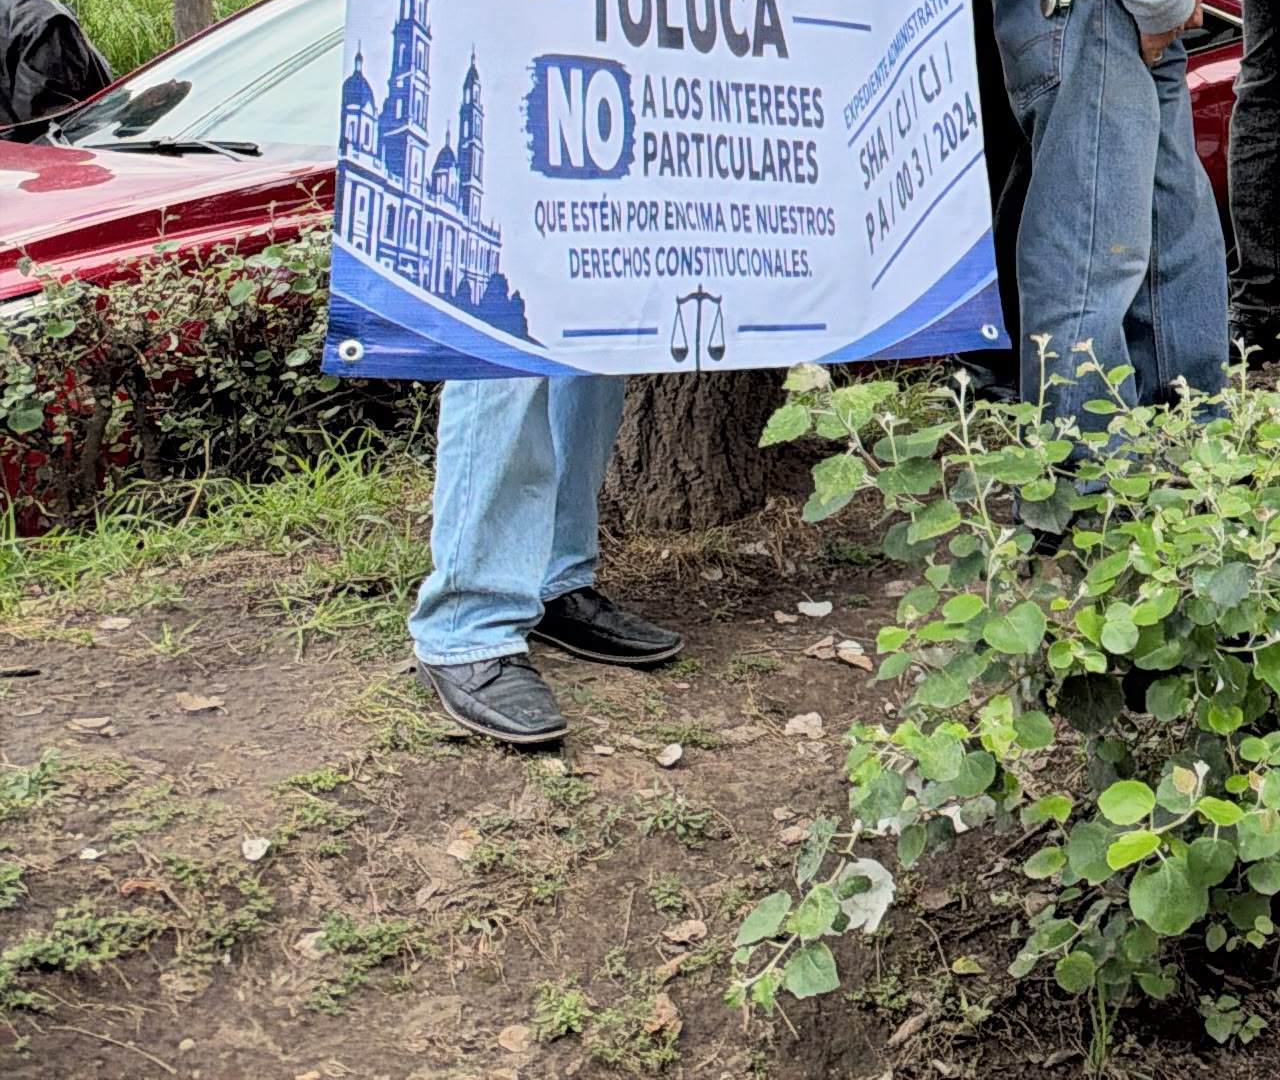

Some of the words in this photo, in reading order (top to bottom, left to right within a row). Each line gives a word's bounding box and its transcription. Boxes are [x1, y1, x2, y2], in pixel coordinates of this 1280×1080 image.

[547, 66, 628, 171] NO
[642, 75, 668, 118] A
[671, 77, 704, 121] LOS
[710, 81, 825, 129] INTERESES
[843, 57, 889, 130] EXPEDIENTE
[643, 131, 819, 184] PARTICULARES
[535, 201, 568, 236] QUE
[571, 192, 623, 233] ESTÉN
[628, 201, 660, 233] POR
[665, 201, 727, 234] ENCIMA
[732, 204, 752, 234] DE
[757, 205, 836, 236] NUESTROS
[569, 248, 651, 279] DERECHOS
[656, 248, 813, 279] CONSTITUCIONALES.
